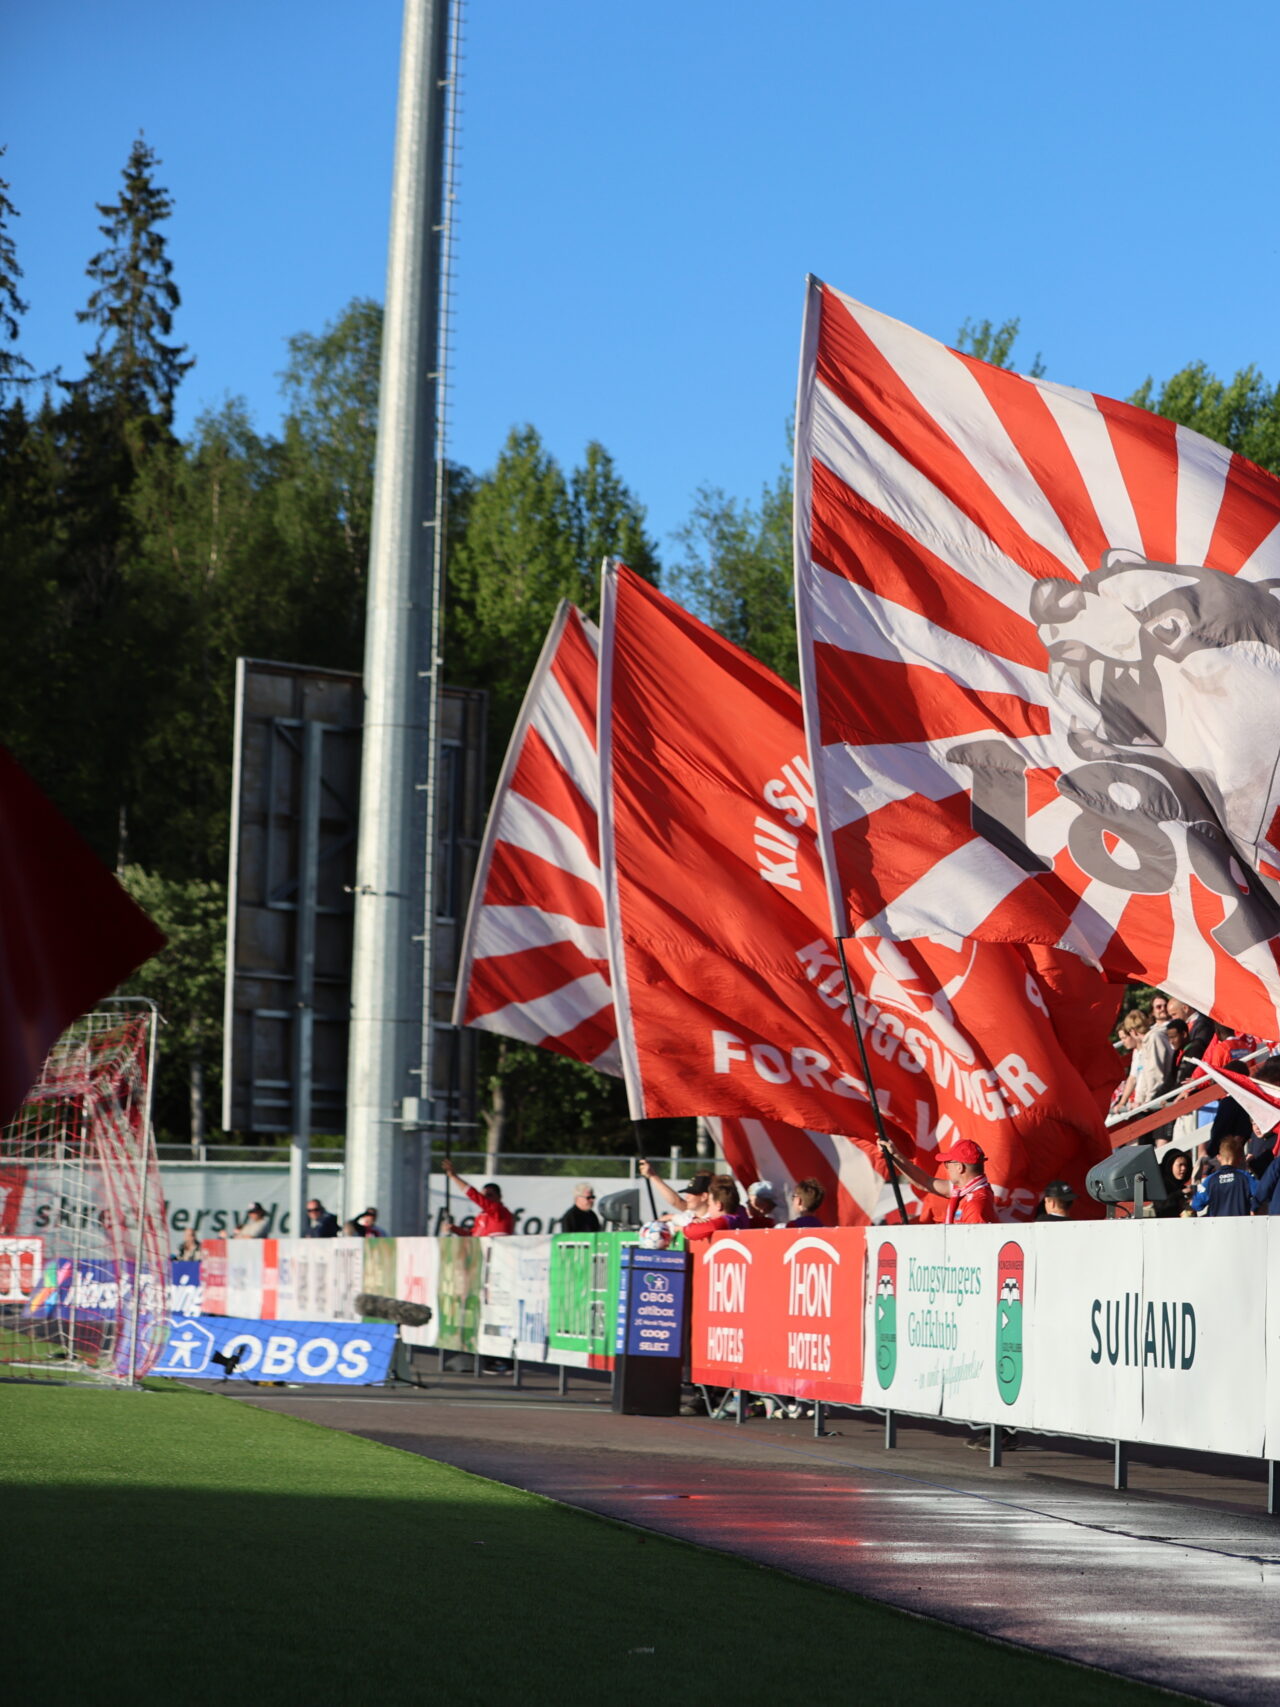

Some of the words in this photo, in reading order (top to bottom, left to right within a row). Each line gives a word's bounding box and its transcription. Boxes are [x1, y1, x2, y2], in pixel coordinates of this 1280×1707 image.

[703, 1238, 753, 1313] THON
[783, 1236, 841, 1317] THON
[908, 1255, 982, 1307] Kongsvingers
[640, 1292, 674, 1303] OBOS
[639, 1341, 670, 1351] SELECT
[640, 1329, 670, 1340] coop
[707, 1326, 744, 1363] HOTELS
[908, 1309, 958, 1351] Golfklubb
[225, 1334, 372, 1378] OBOS
[788, 1332, 831, 1373] HOTELS
